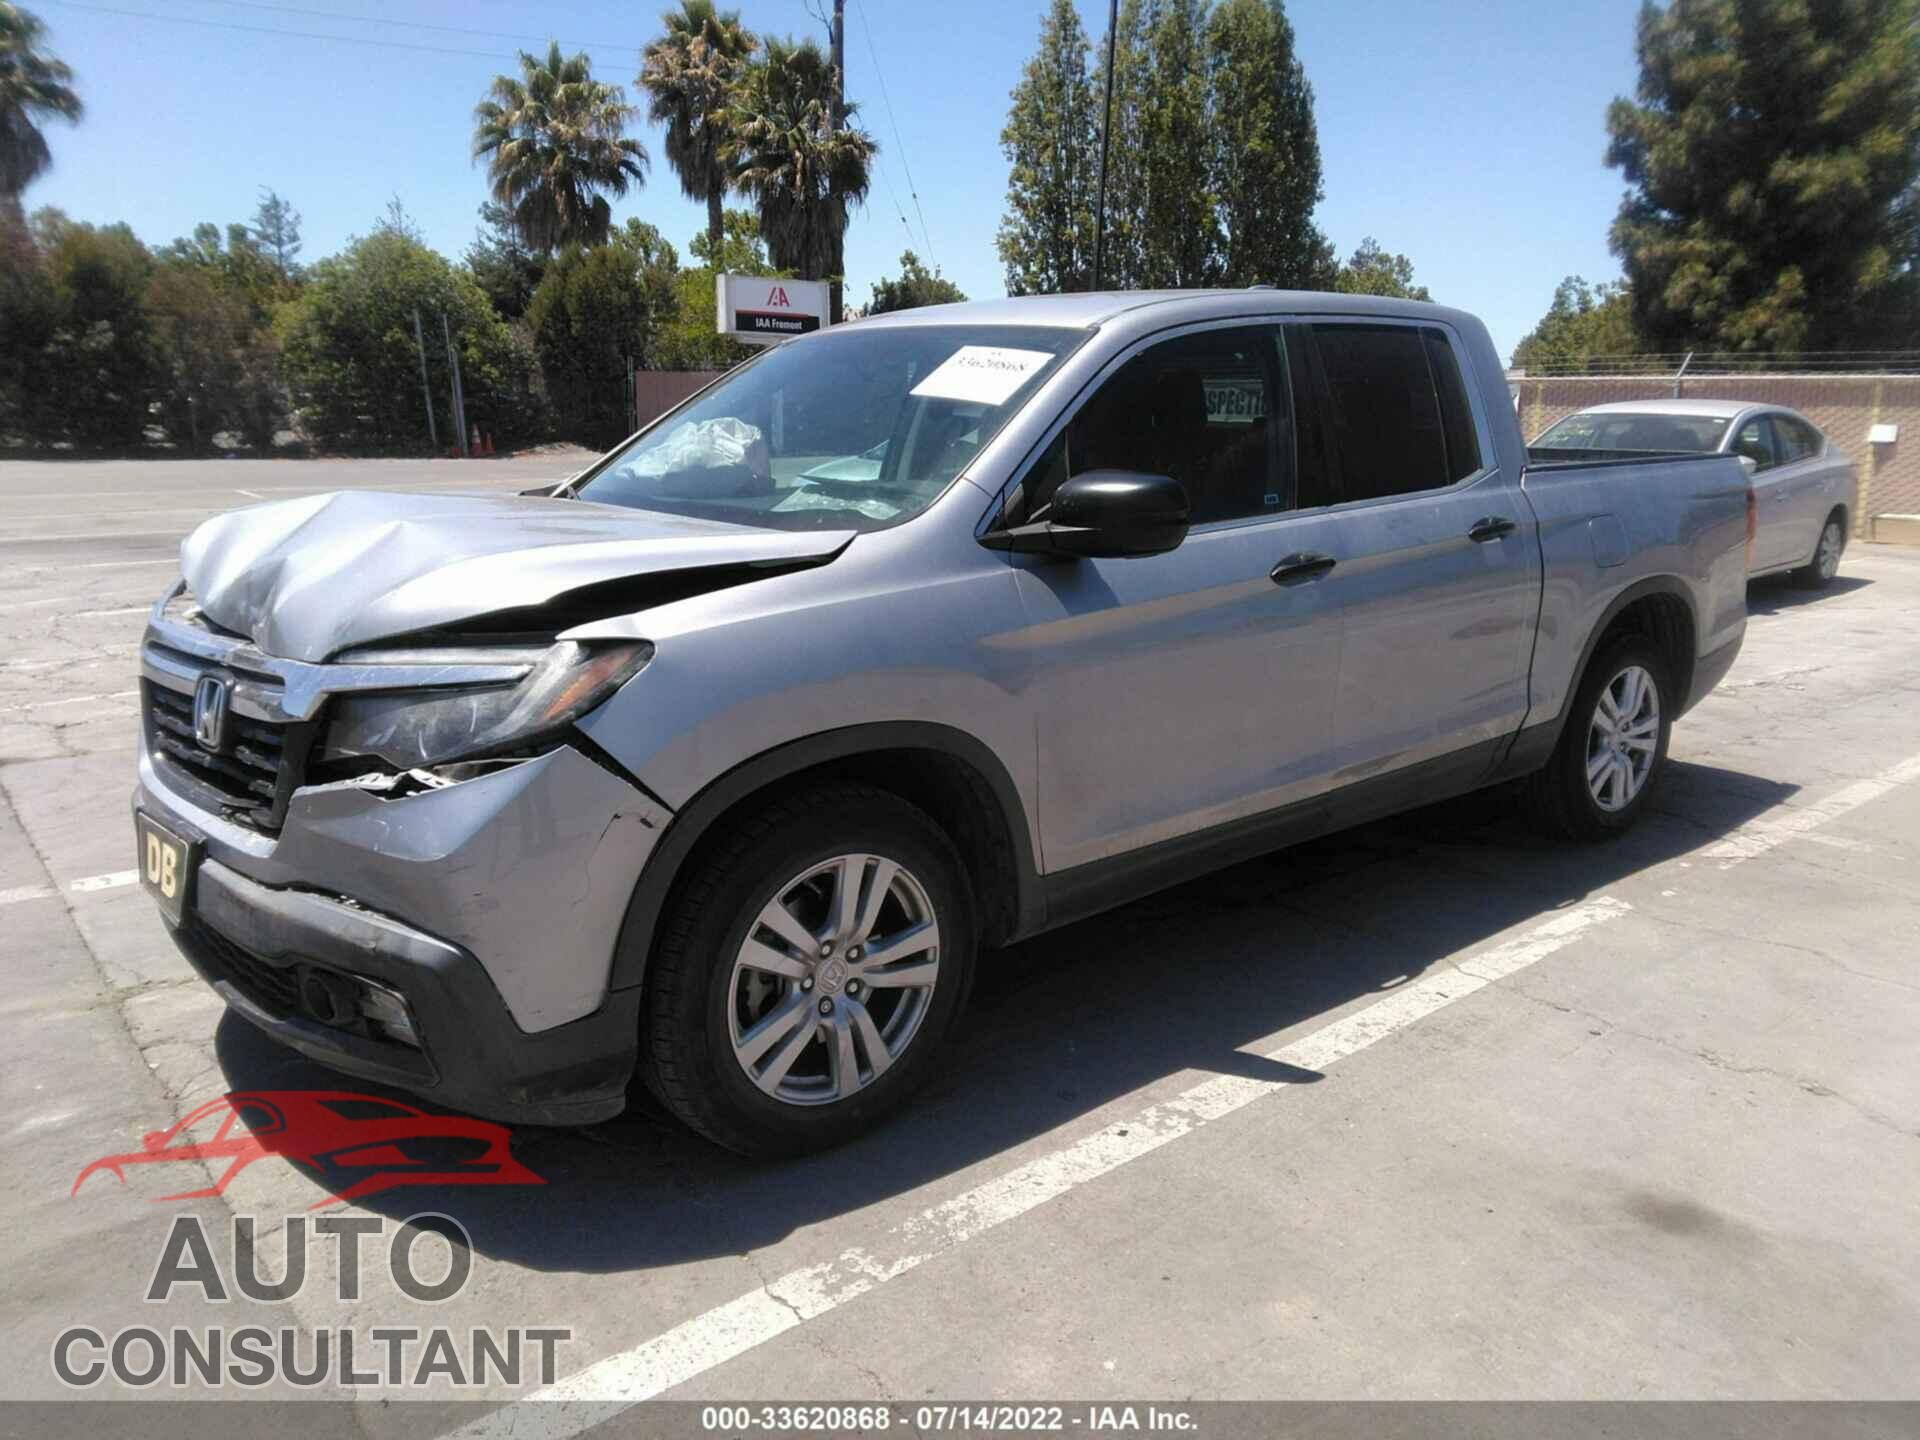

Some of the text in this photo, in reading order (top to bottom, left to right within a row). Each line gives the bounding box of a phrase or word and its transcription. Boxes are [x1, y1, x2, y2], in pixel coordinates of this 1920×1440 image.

[755, 317, 803, 330] IAA Fremont
[146, 831, 177, 898] DB
